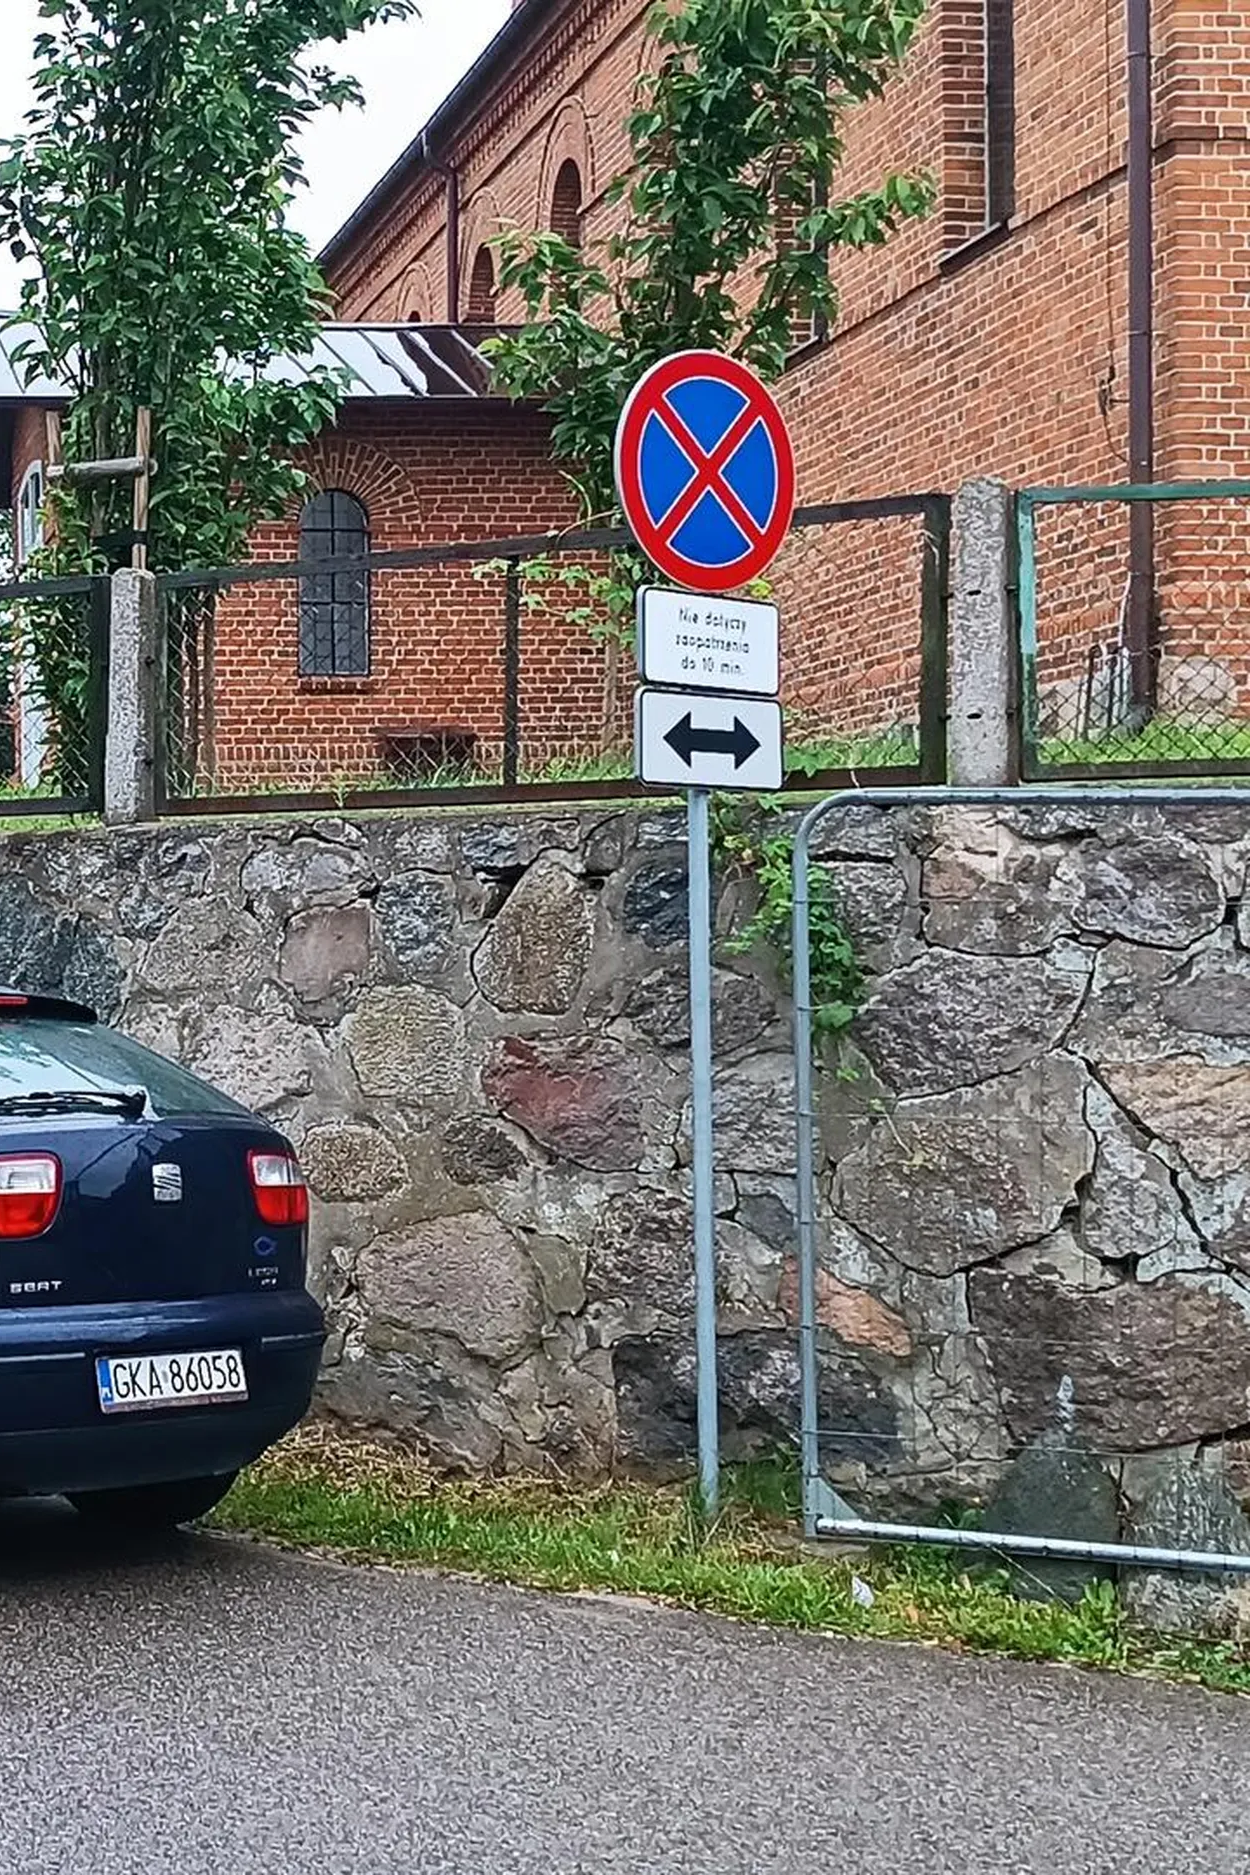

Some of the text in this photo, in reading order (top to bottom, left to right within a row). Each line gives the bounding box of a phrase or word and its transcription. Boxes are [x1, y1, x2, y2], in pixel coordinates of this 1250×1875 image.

[678, 606, 747, 635] Nie dotyczy
[675, 634, 749, 654] zaopatrzenia
[681, 656, 696, 670] do
[702, 657, 714, 673] 10
[10, 1281, 62, 1294] SEAT
[113, 1355, 241, 1398] GKA 86058
